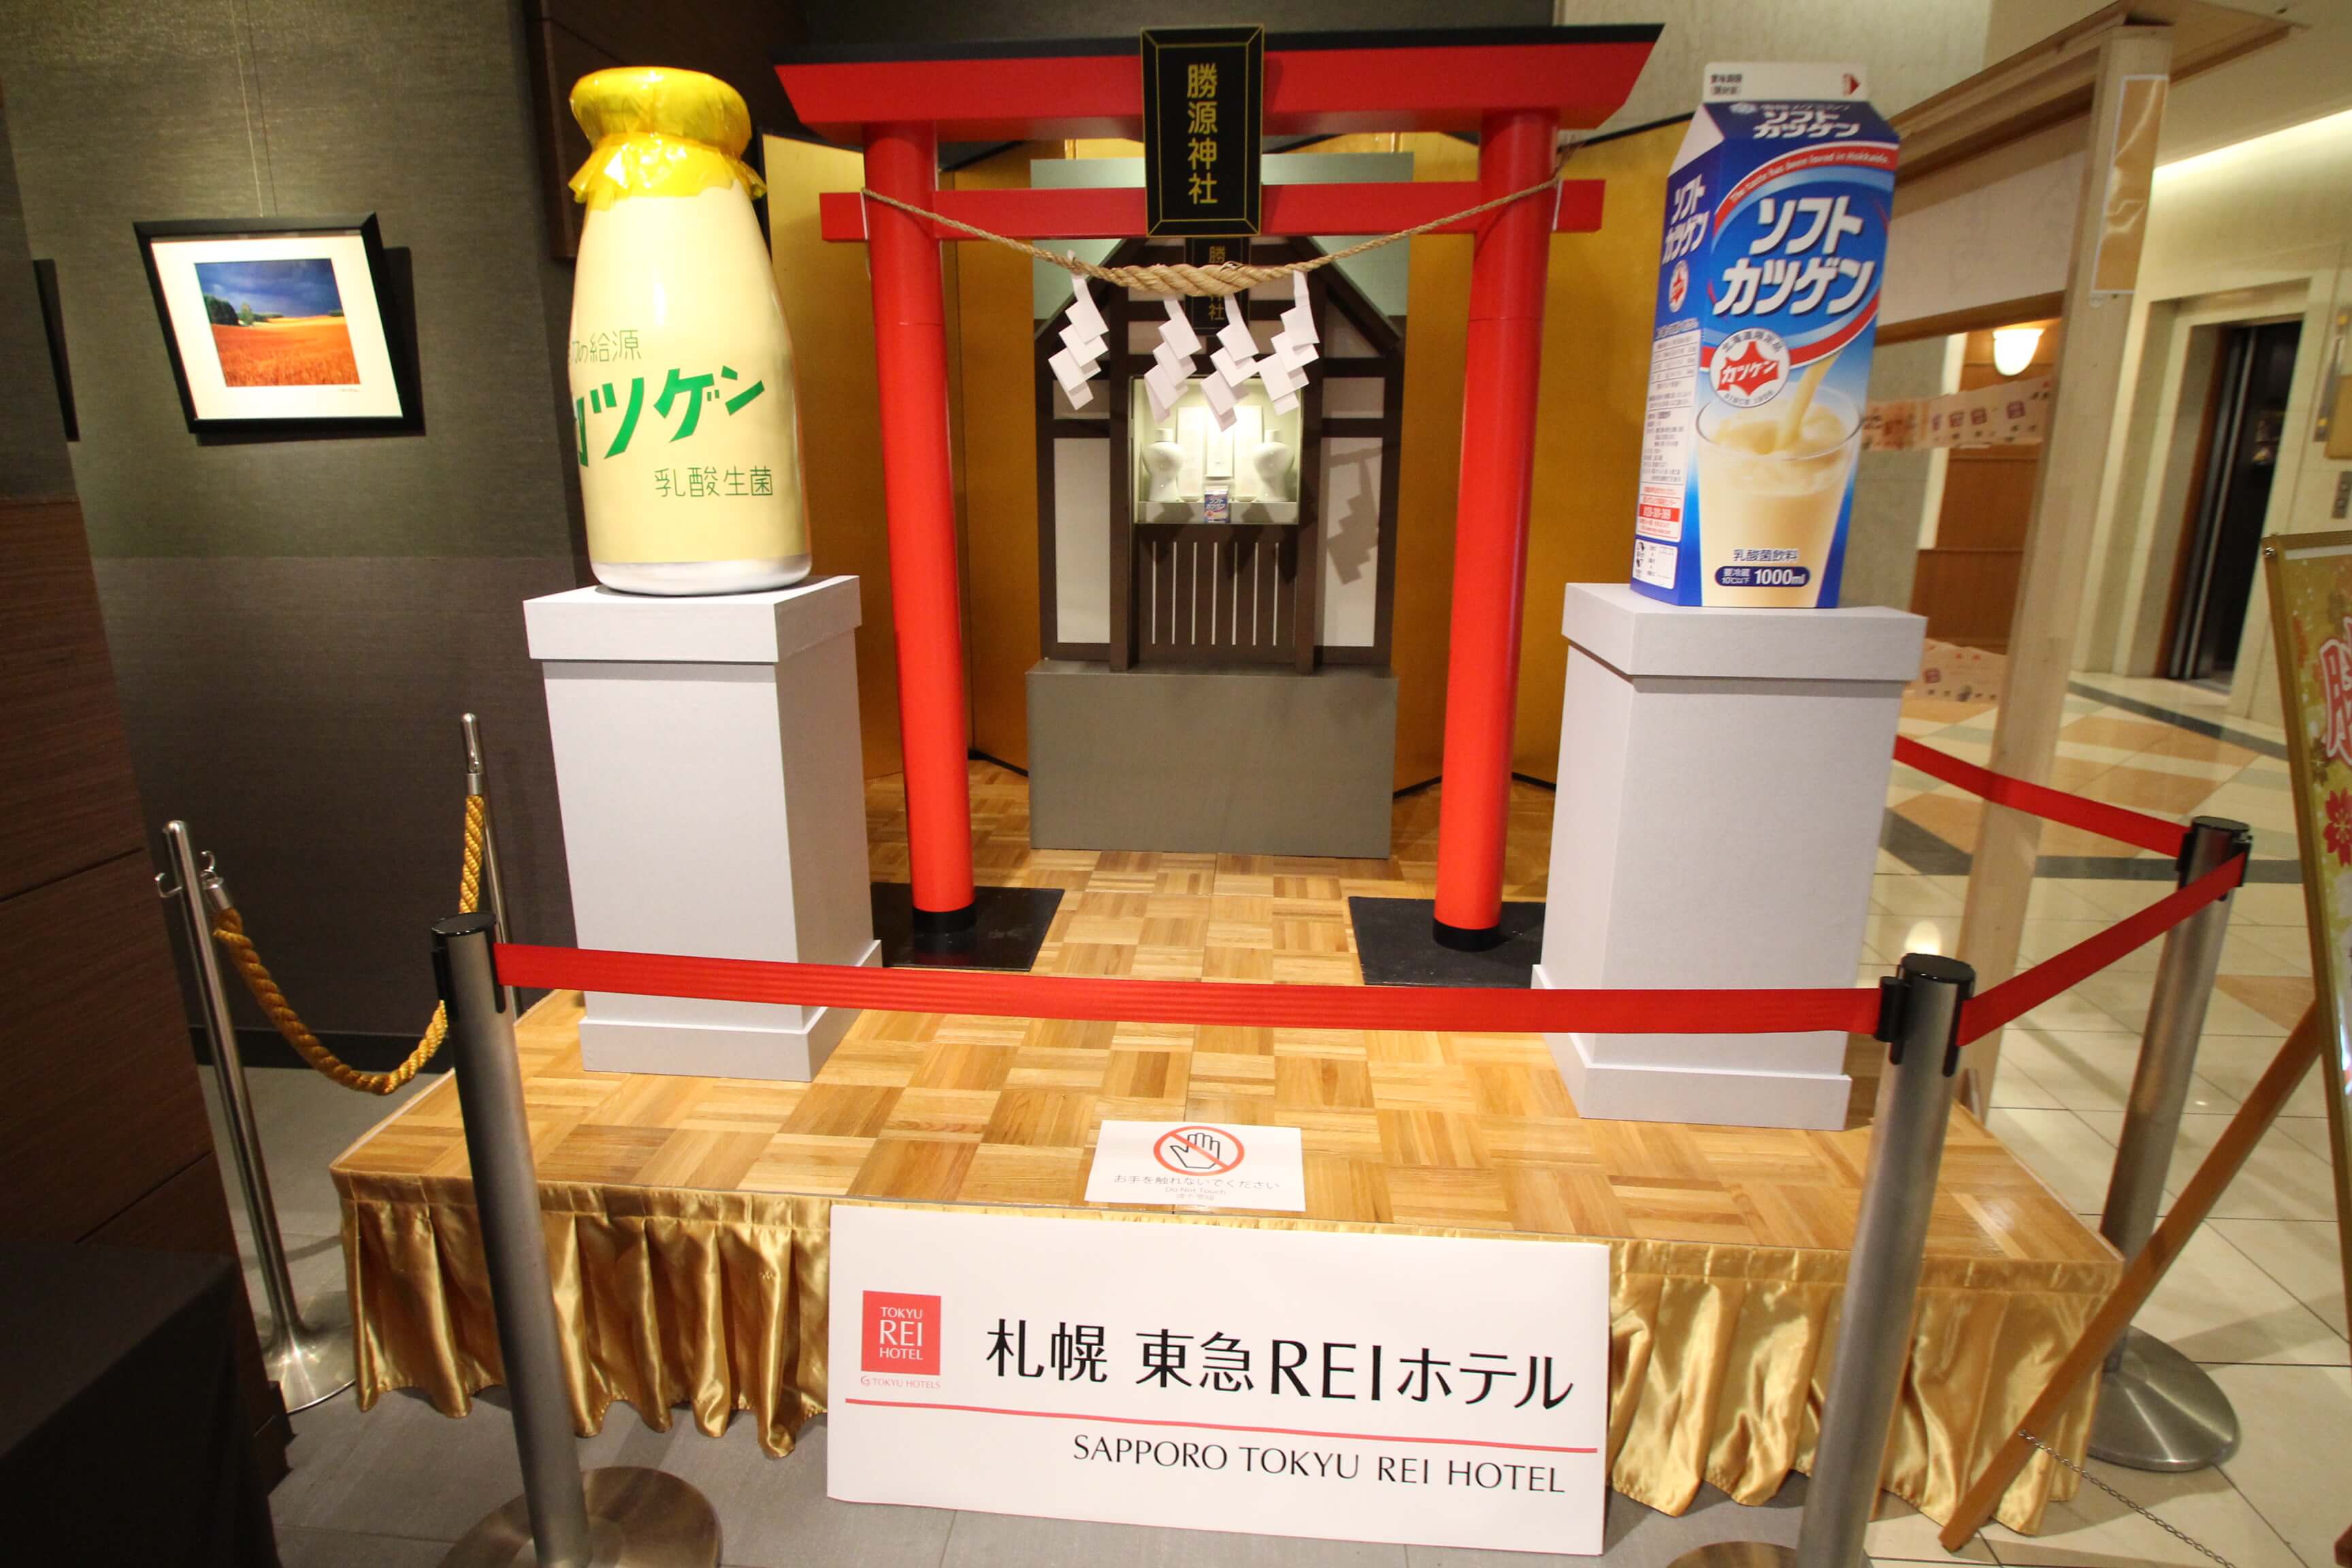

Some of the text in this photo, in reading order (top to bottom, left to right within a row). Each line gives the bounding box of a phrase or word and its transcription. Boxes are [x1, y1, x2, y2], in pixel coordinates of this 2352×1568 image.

[1763, 110, 1840, 125] ソフト
[1187, 63, 1218, 204] 勝源神社
[1752, 122, 1861, 139] カツゲン
[1671, 174, 1706, 220] ソフト
[1749, 195, 1863, 255] ソフト
[1662, 210, 1710, 265] カツゲン
[1712, 257, 1876, 315] カツゲン
[655, 466, 773, 497] 乳酸生菌
[1733, 549, 1797, 562] 乳酸菌飲料
[1754, 568, 1806, 585] 1000ml
[1113, 1175, 1280, 1190] お手を触れないでください
[1199, 1188, 1226, 1196] Touch
[880, 1307, 924, 1320] TOKYU
[879, 1319, 924, 1347] REI
[879, 1347, 924, 1360] HOTEL
[986, 1318, 1574, 1409] 札幌 東急REIホテル
[872, 1377, 941, 1389] TOKYU HOTELS
[1073, 1434, 1565, 1493] SAPPORO TOKYU REI HOTEL
